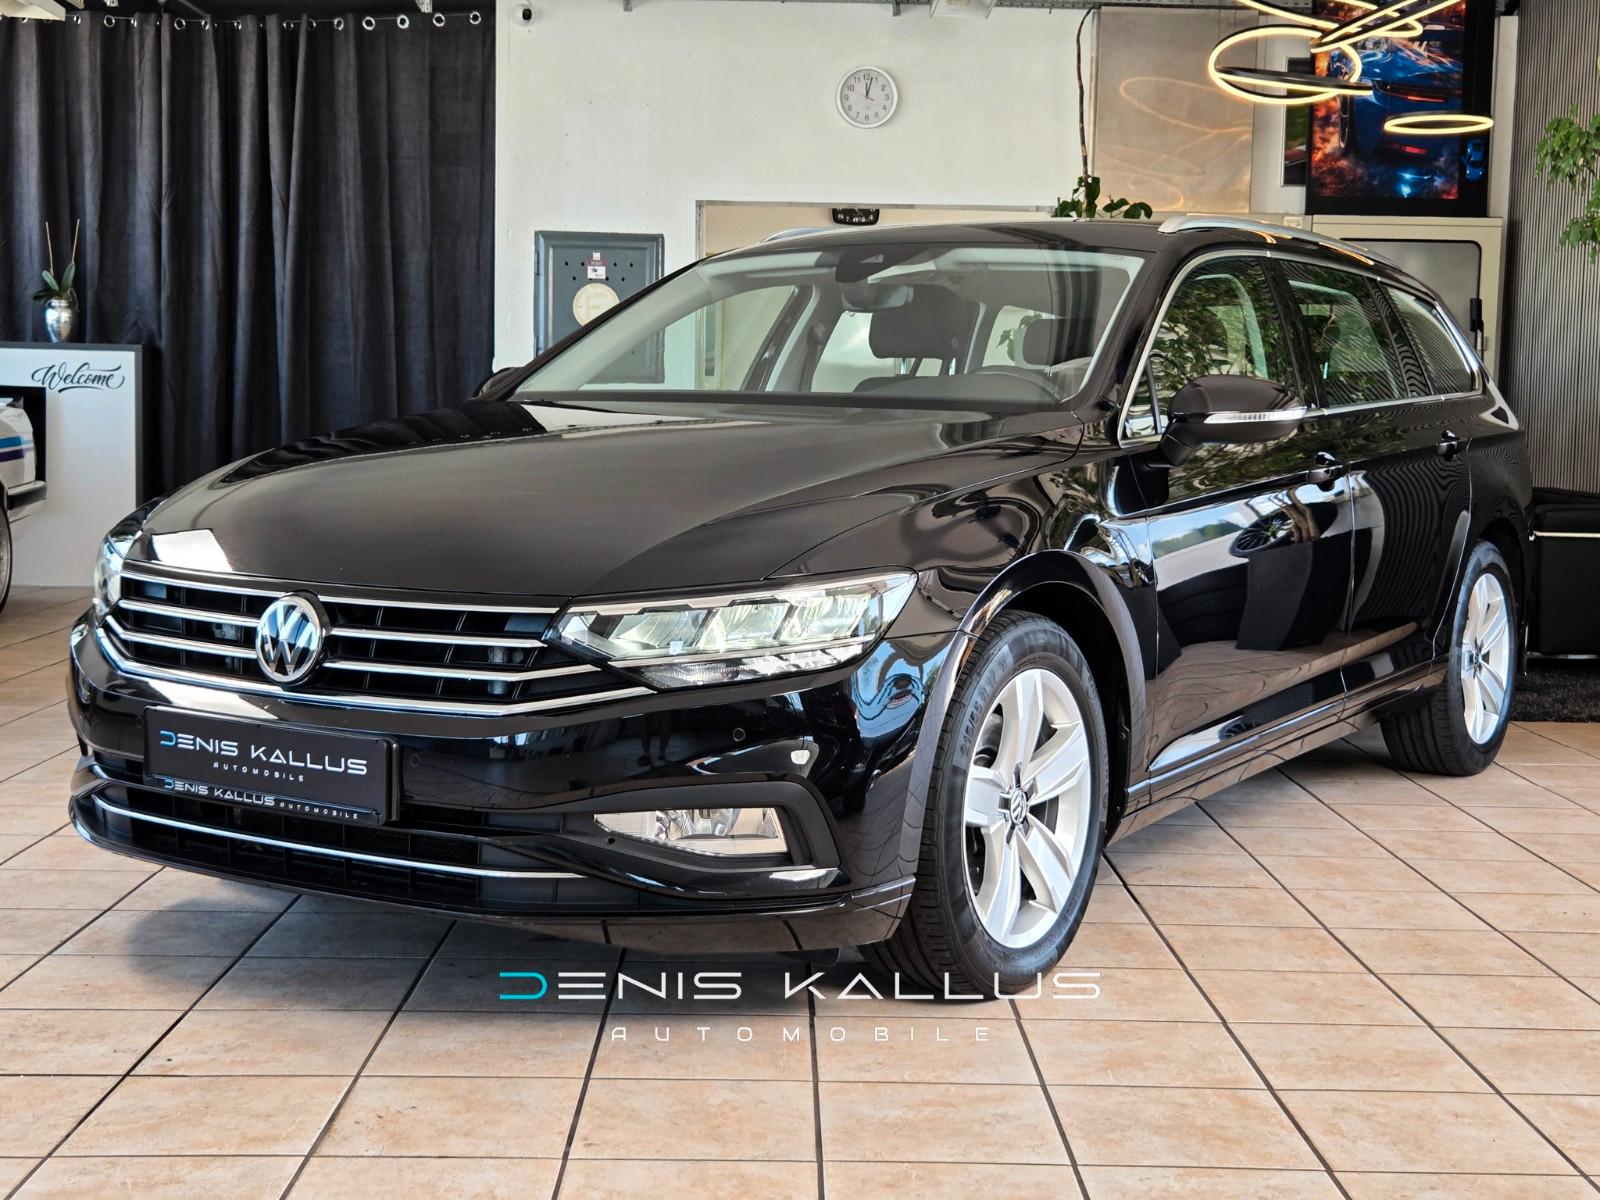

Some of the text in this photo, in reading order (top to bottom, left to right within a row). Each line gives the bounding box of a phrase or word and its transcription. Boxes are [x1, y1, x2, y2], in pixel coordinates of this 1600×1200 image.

[854, 76, 861, 84] 11
[863, 73, 871, 81] 12
[846, 84, 855, 92] 10
[880, 84, 886, 92] 2
[844, 94, 849, 102] 9
[884, 93, 889, 101] 3
[847, 104, 853, 112] 8
[855, 111, 860, 119] 7
[874, 111, 880, 119] 5
[31, 361, 125, 392] Welcome
[160, 730, 368, 775] DENIS KALLUS
[213, 761, 304, 782] AUTOMOBILE
[164, 779, 359, 820] DENIS KALLUS AUTOMOBILE
